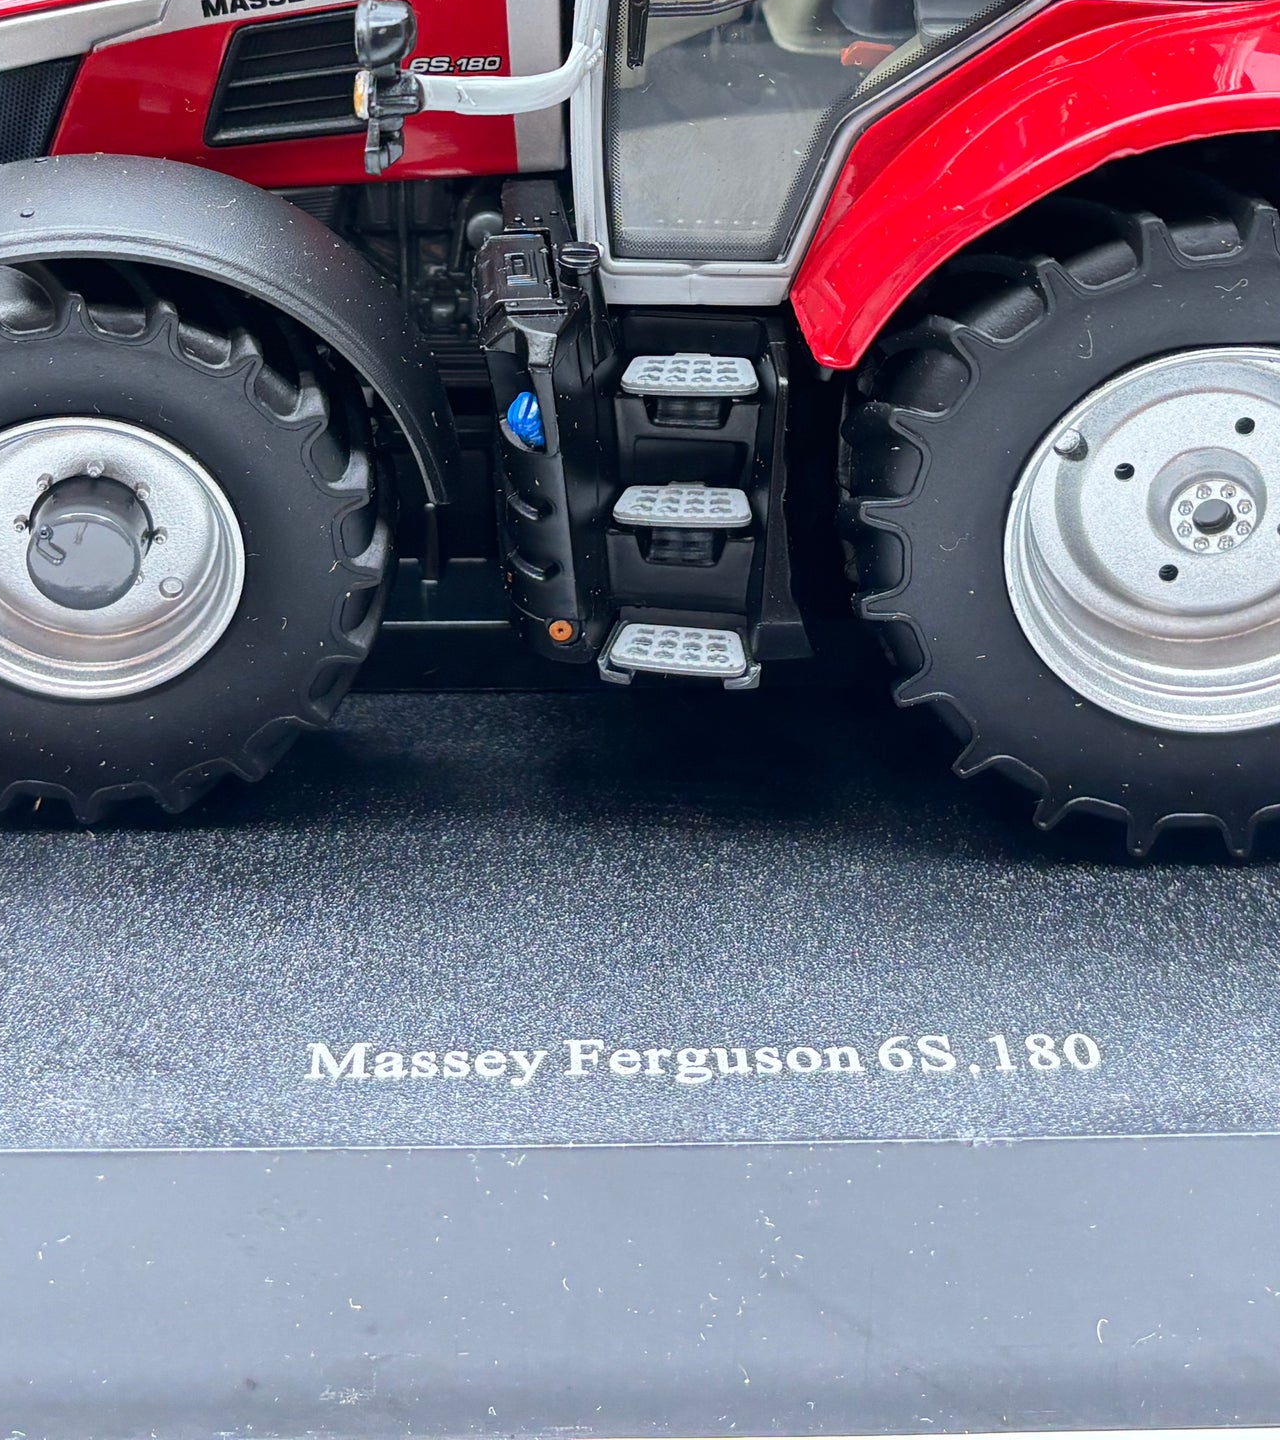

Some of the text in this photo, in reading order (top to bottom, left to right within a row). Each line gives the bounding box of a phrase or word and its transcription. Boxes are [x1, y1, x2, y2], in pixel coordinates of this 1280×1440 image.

[409, 56, 501, 73] 6S.180
[304, 1032, 1102, 1086] Massey Ferguson 6S.180
